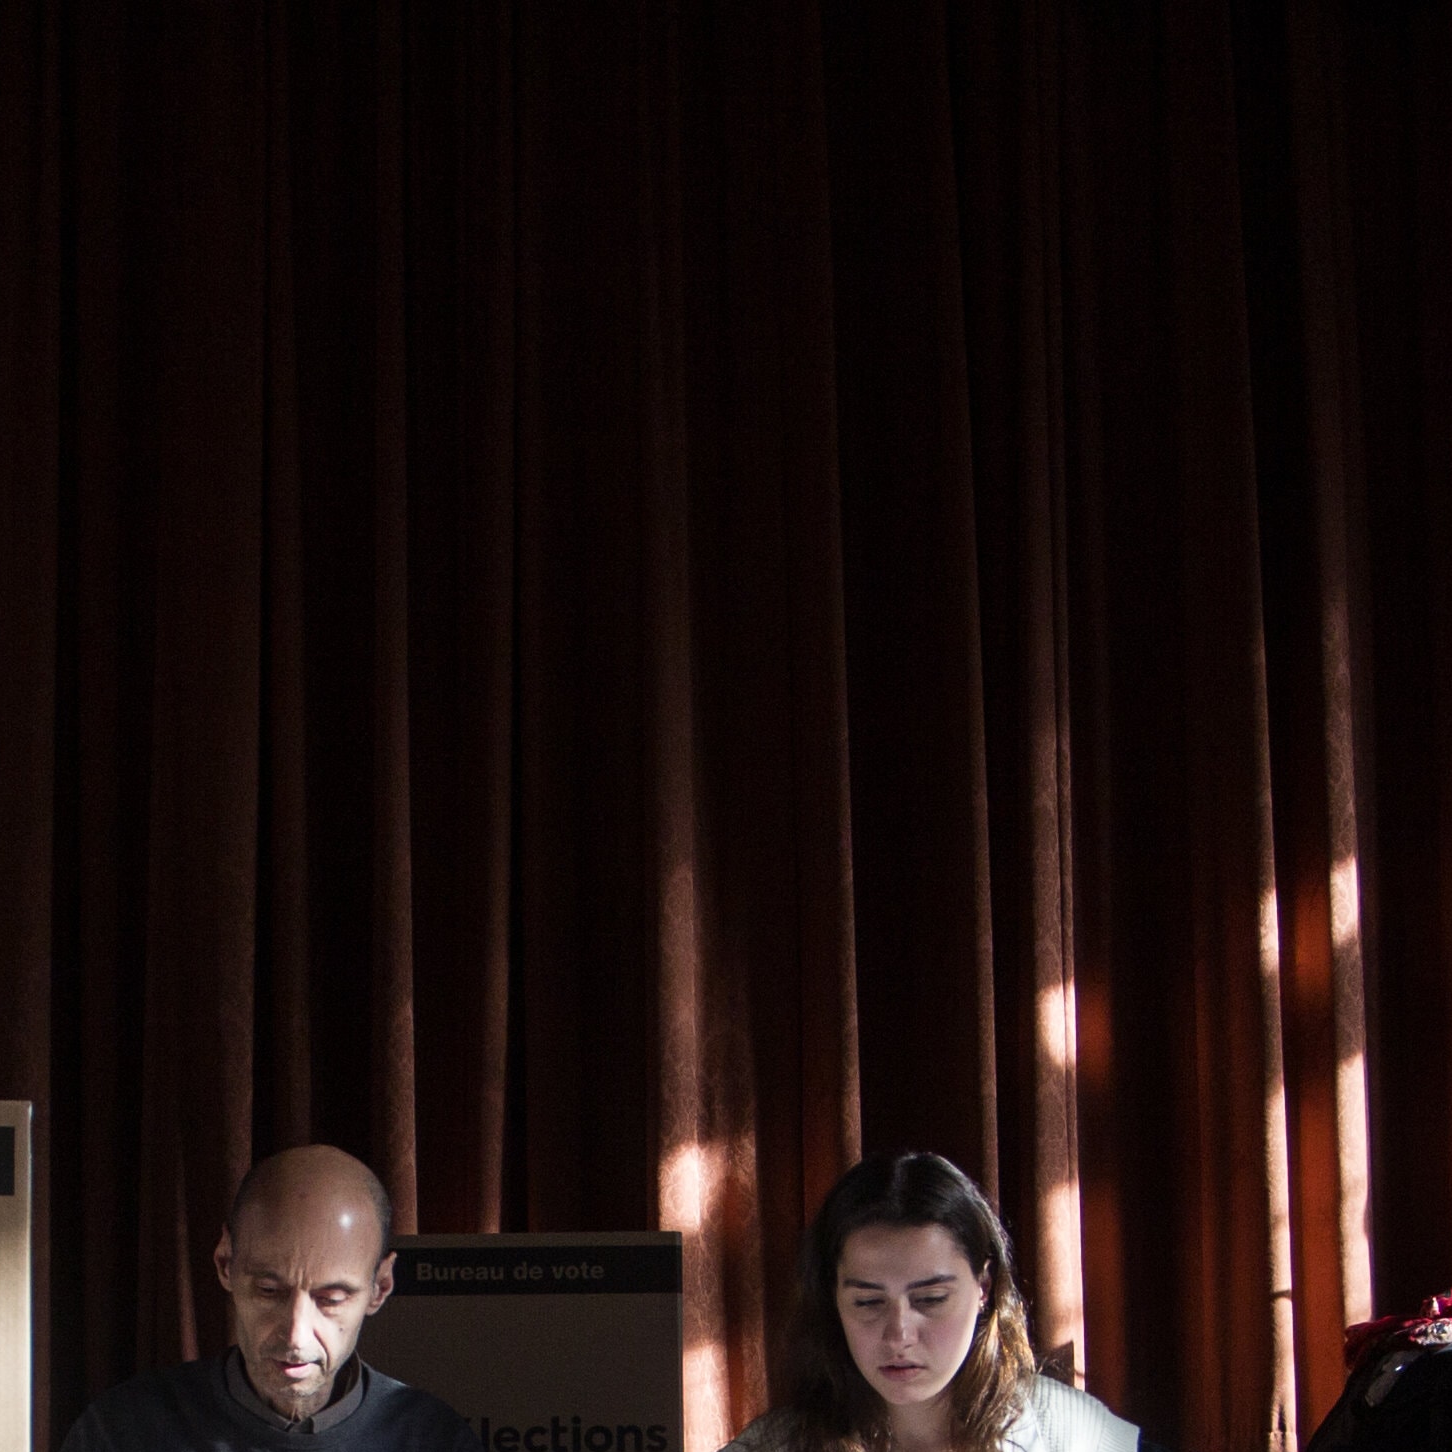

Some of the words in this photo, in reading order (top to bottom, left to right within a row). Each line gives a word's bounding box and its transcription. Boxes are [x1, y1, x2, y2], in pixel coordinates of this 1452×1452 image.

[416, 1262, 504, 1281] Bureau
[513, 1261, 544, 1281] de
[550, 1260, 605, 1280] vote
